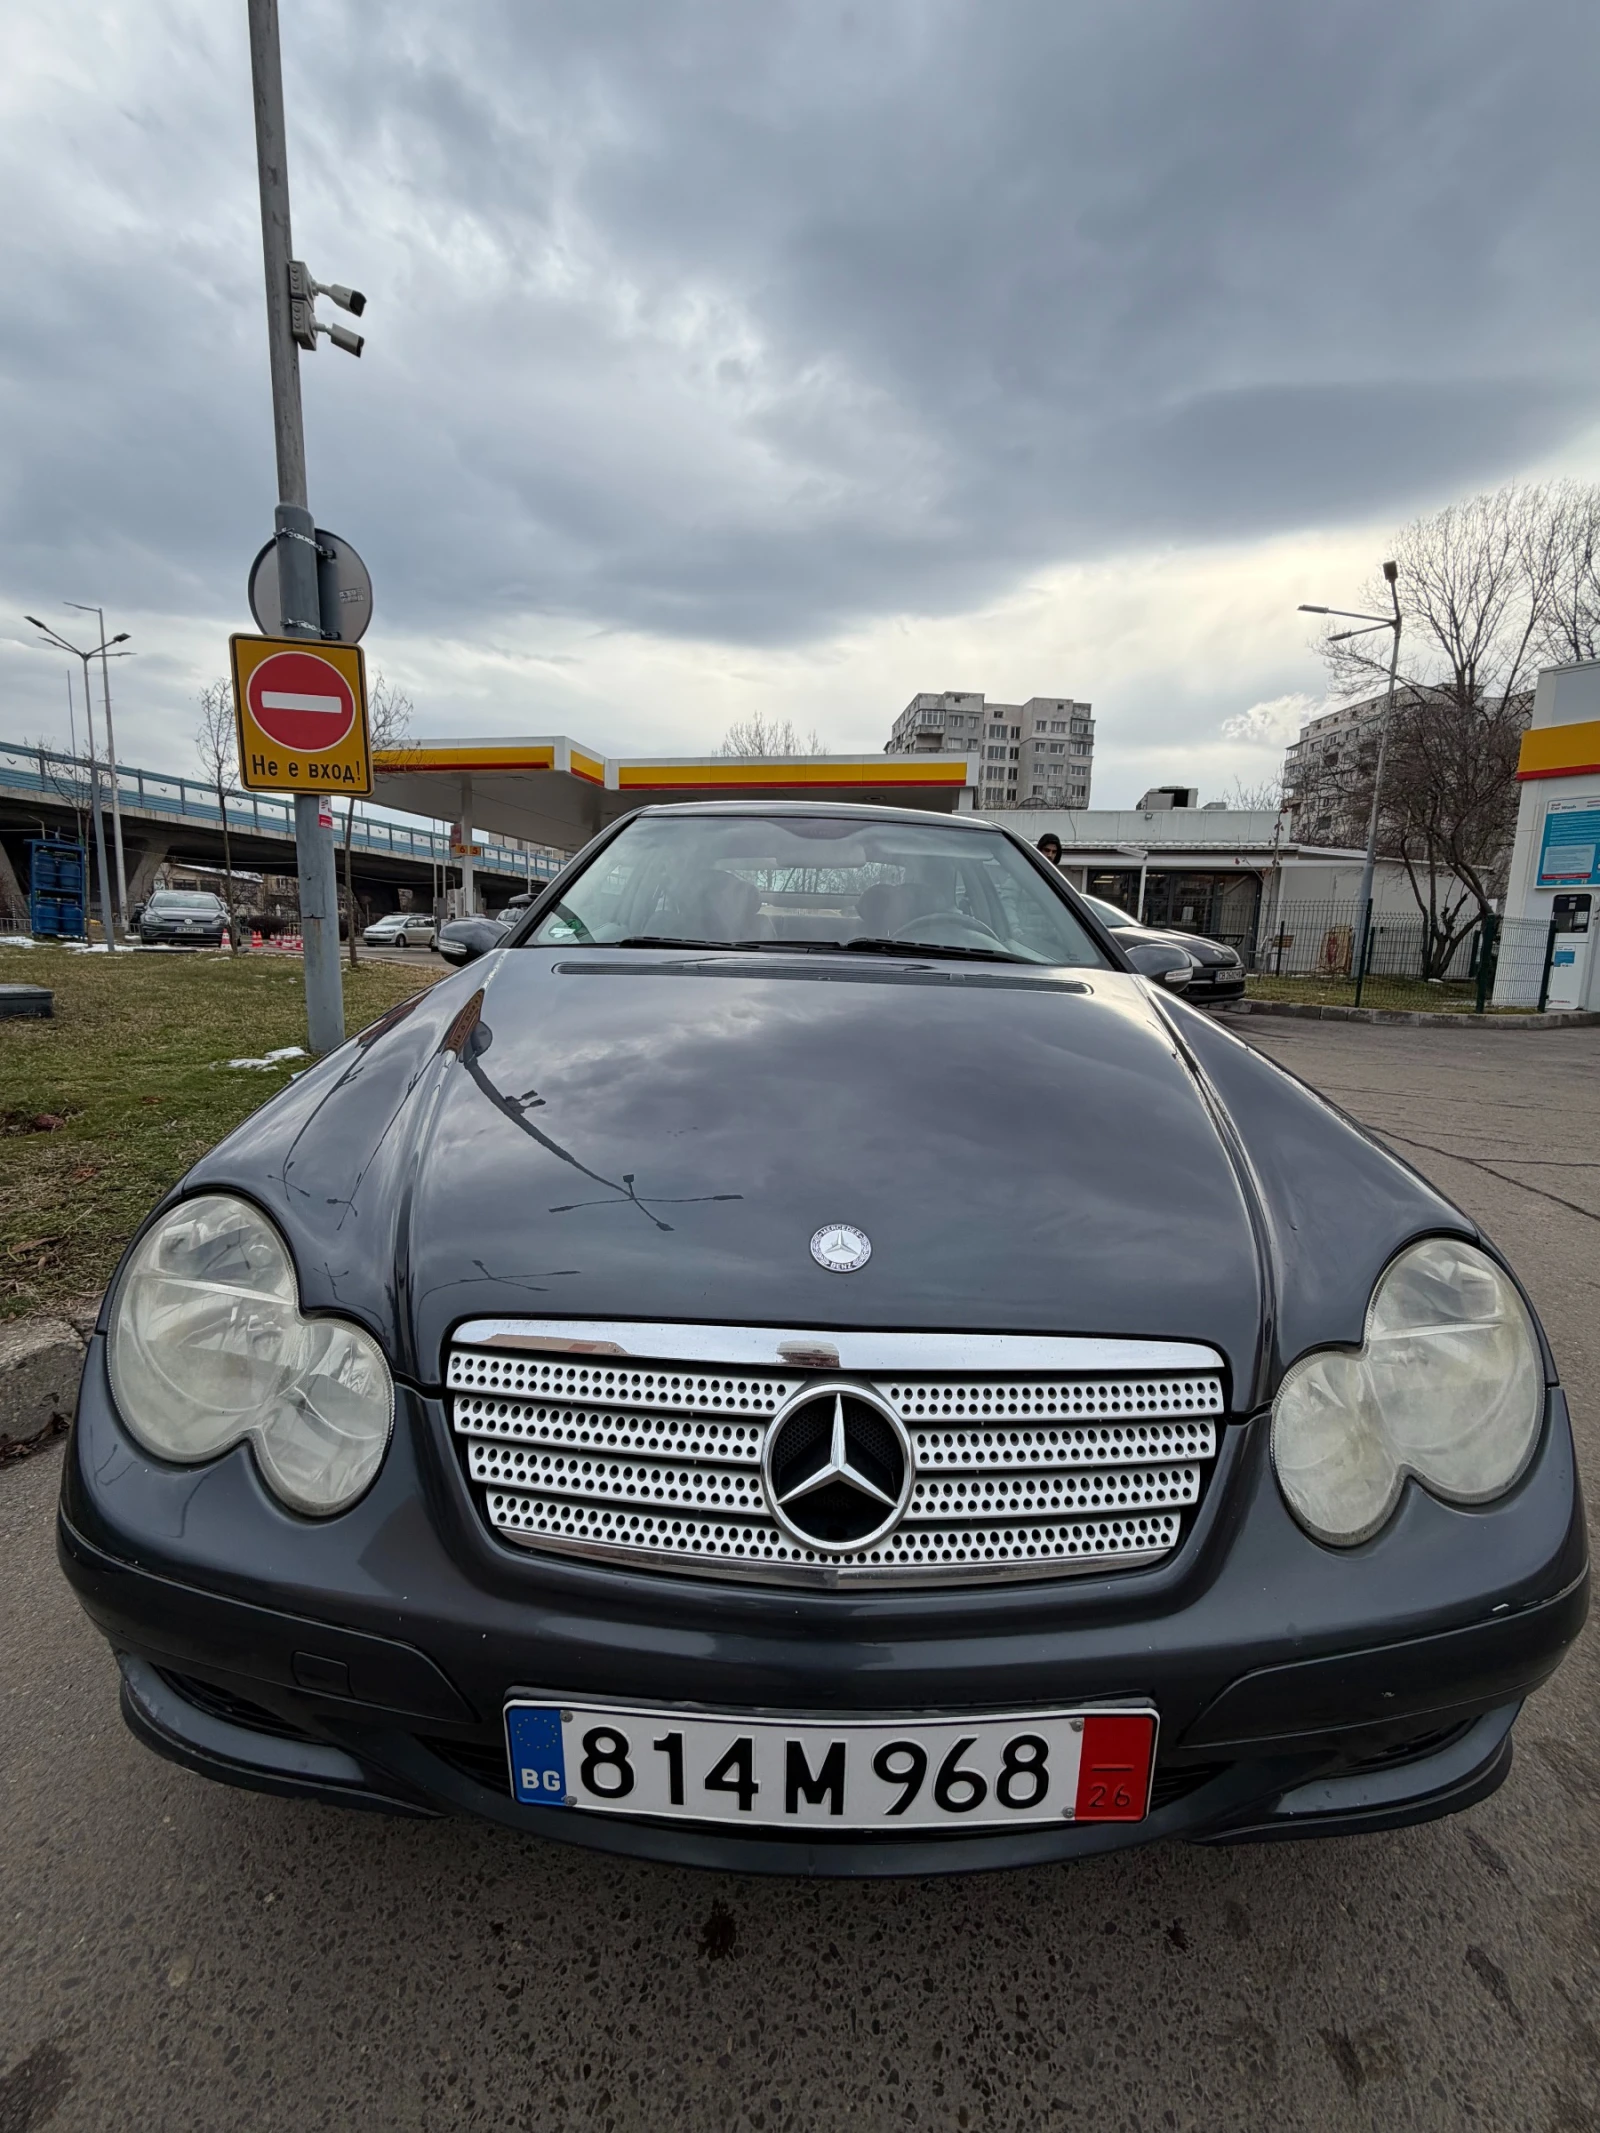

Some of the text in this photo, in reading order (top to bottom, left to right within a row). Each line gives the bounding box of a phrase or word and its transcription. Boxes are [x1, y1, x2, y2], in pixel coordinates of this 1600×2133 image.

[252, 754, 361, 782] Не е вход!
[459, 846, 466, 854] 6
[472, 847, 478, 855] 5
[821, 1225, 860, 1236] MERCEDES
[830, 1262, 853, 1270] BENZ
[521, 1767, 562, 1792] BG
[1088, 1782, 1131, 1808] 26
